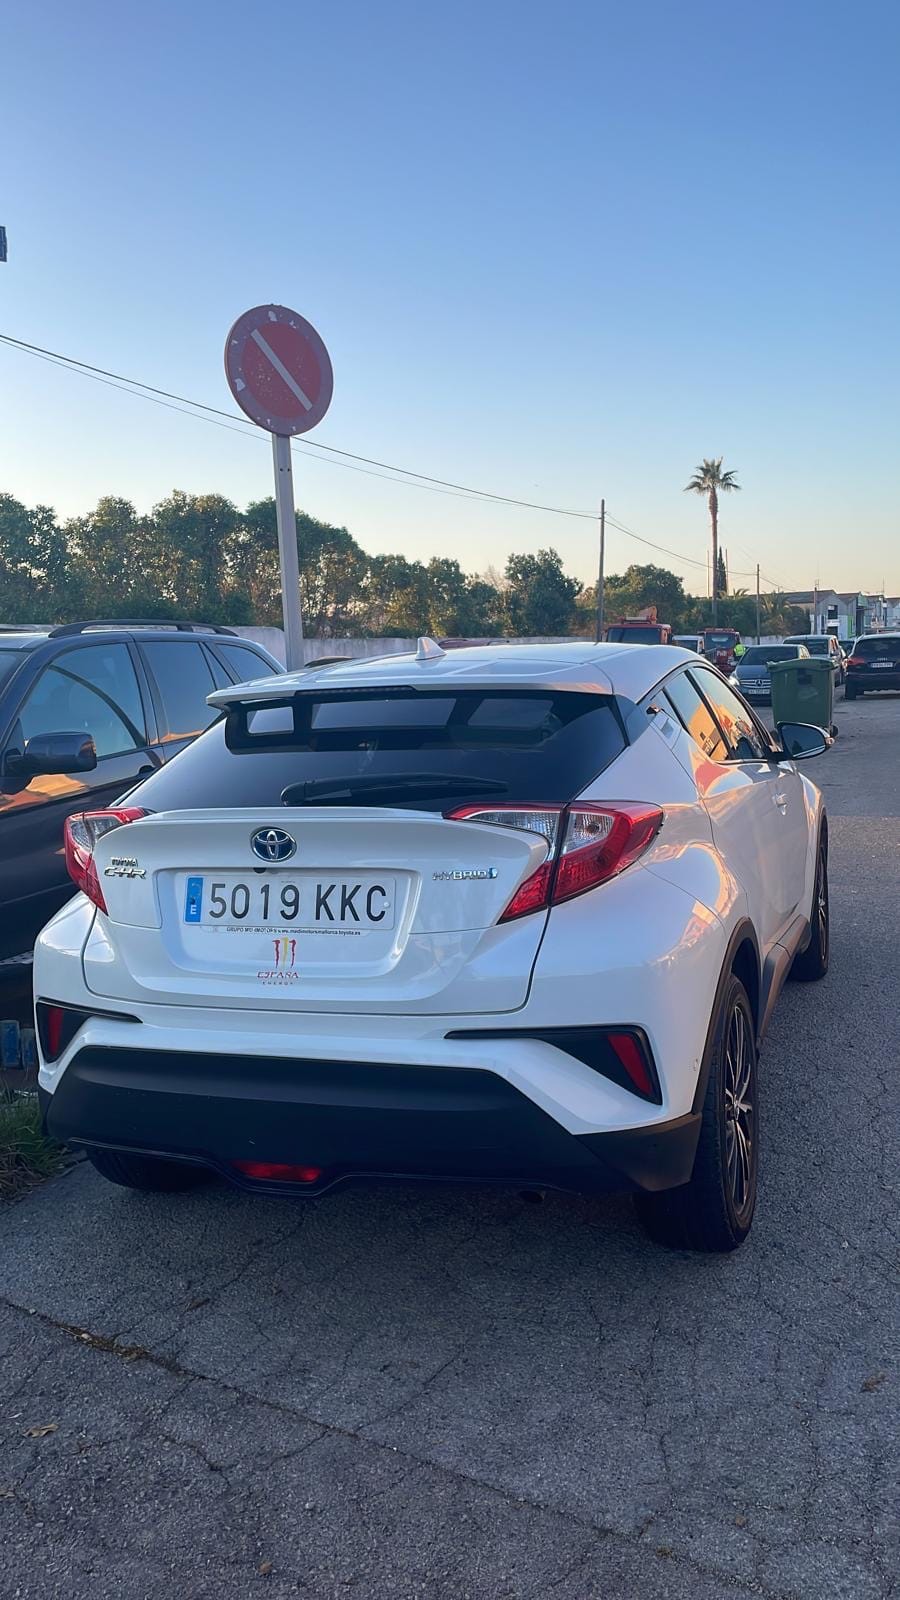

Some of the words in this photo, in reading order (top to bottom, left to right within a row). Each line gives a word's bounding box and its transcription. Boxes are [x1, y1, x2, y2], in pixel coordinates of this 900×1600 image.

[111, 857, 138, 867] TOYOTA
[104, 867, 146, 879] C-HR
[432, 870, 487, 880] HYBRID
[208, 883, 300, 921] 5019
[315, 884, 387, 922] KKC
[190, 904, 197, 915] E
